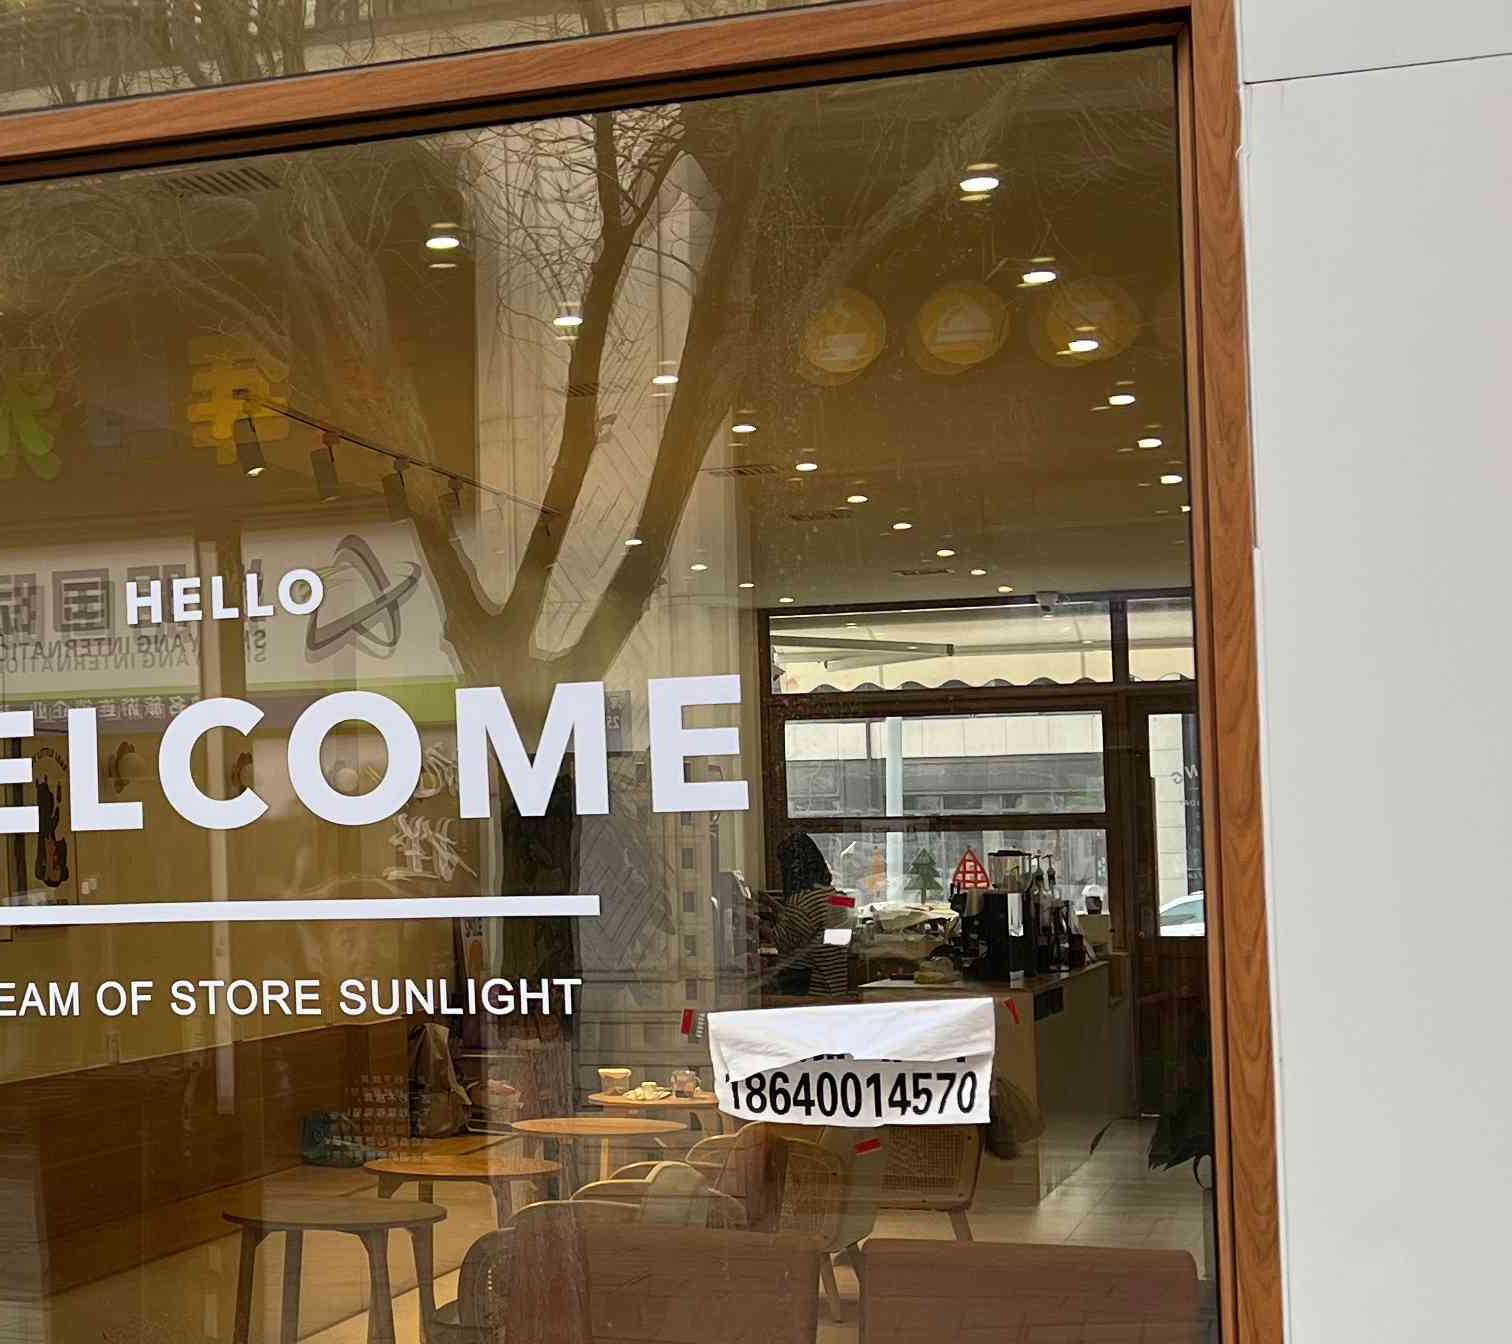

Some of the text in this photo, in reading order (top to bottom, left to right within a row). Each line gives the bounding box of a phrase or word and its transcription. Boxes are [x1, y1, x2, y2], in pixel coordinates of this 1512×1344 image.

[126, 568, 324, 625] HELLO
[96, 980, 153, 1017] OF
[170, 979, 322, 1016] STORE
[339, 978, 582, 1016] SUNLIGHT
[725, 1070, 978, 1118] 18640014570
